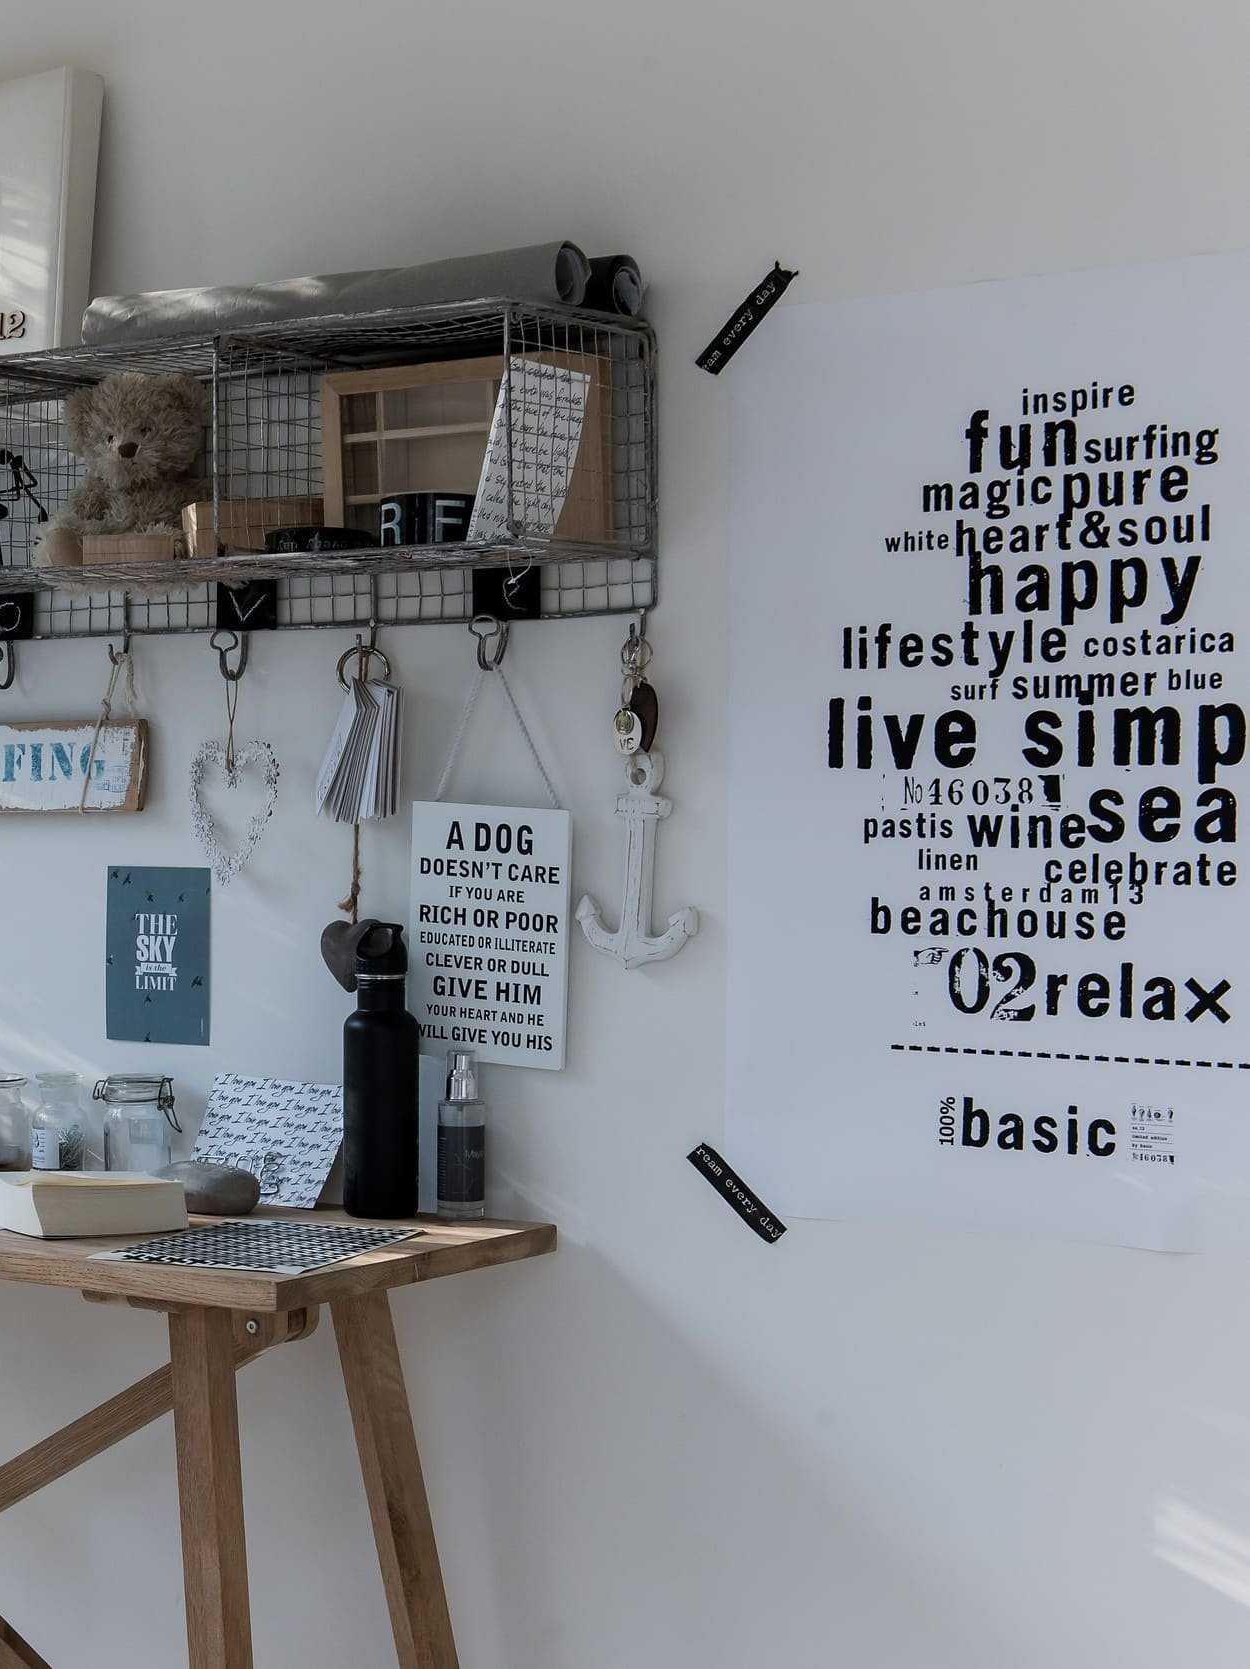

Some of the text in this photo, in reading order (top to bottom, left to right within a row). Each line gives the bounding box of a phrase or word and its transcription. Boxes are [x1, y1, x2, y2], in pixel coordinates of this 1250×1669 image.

[723, 308, 754, 346] every
[756, 281, 776, 305] day
[1022, 382, 1135, 416] inspire
[965, 410, 1219, 473] fun surfing
[922, 465, 1189, 520] magic pure
[885, 529, 949, 552] white
[968, 551, 1201, 625] happy
[843, 620, 1235, 678] lifestyle costarica
[950, 669, 1223, 701] surf summer blue
[828, 696, 976, 769] live
[864, 804, 1086, 849] pastis wine
[1086, 786, 1238, 843] sea
[446, 821, 533, 856] A DOG
[420, 857, 560, 884] DOESN'T CARE
[918, 849, 1237, 886] linen celebrate
[449, 885, 525, 903] IF YOU ARE
[135, 914, 178, 936] THE
[419, 904, 559, 934] RICH OR POOR
[870, 897, 1126, 940] beachouse
[136, 934, 176, 962] SKY
[420, 931, 556, 955] EDUCATED OR ILLITERATE
[154, 964, 167, 972] the
[425, 953, 550, 977] CLEVER OR DULL
[135, 975, 177, 991] LIMIT
[433, 975, 542, 1006] GIVE HIM
[949, 947, 1232, 1024] 02 relax
[426, 1003, 545, 1027] YOUR HEART AND HE
[452, 1026, 487, 1043] GIVE
[491, 1030, 521, 1047] YOU
[526, 1034, 553, 1051] HIS
[938, 1097, 956, 1146] 100%
[961, 1097, 1116, 1157] basic
[696, 1147, 783, 1238] ream every day
